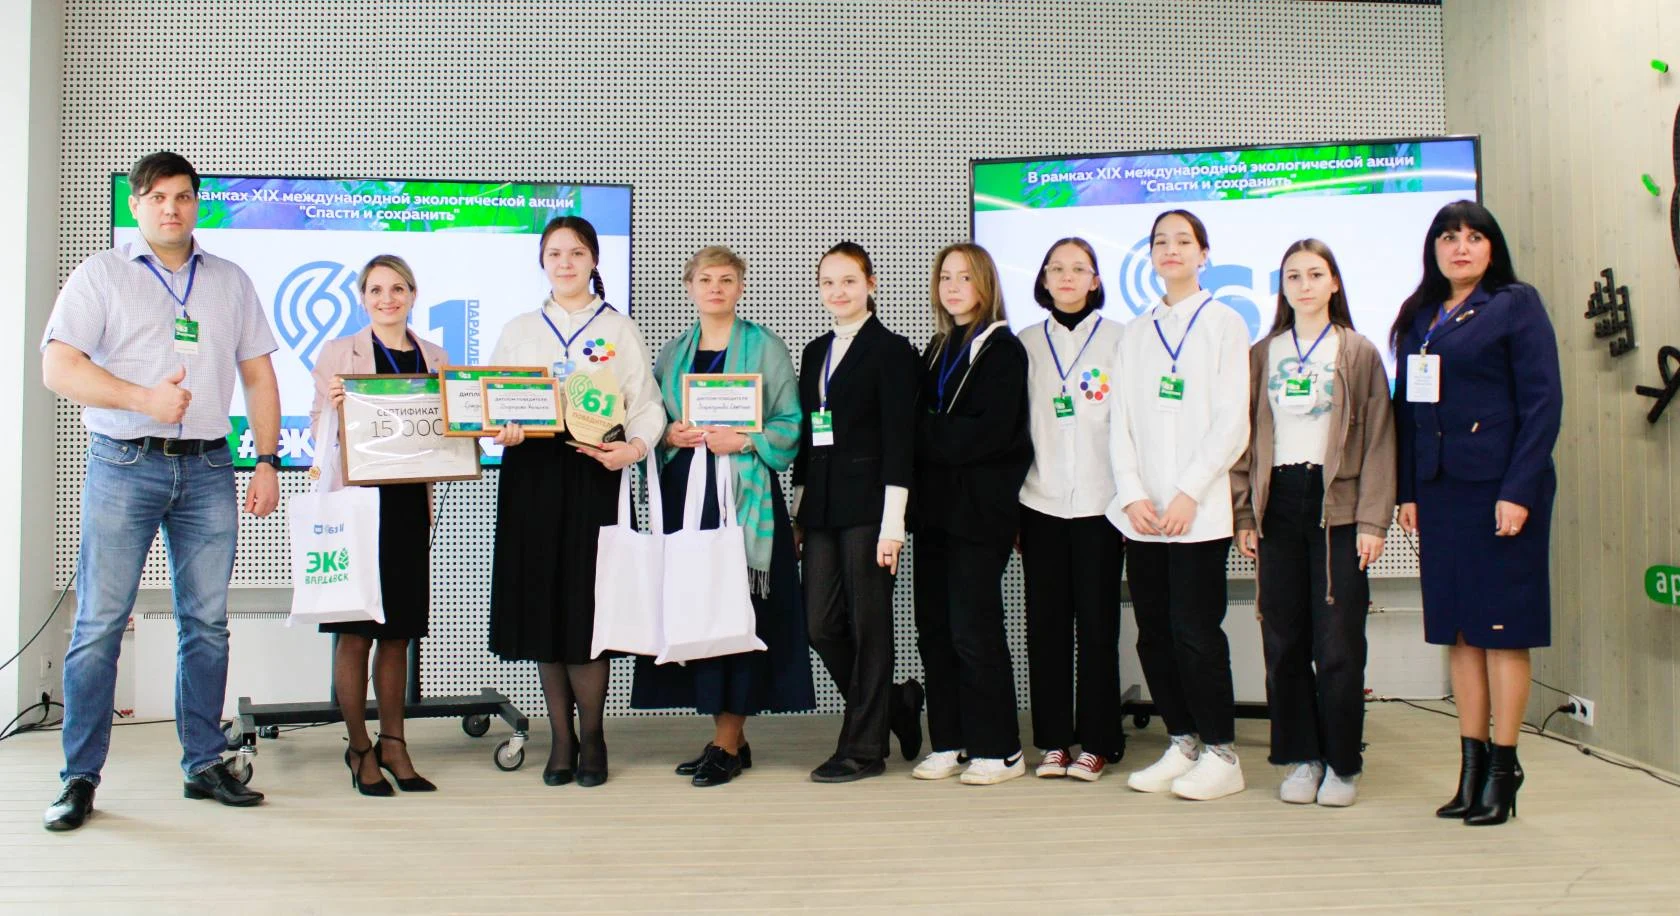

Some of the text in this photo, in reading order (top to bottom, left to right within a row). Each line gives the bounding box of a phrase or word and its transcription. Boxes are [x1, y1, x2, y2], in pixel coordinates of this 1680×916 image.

[1028, 171, 1038, 183] В
[1041, 171, 1093, 186] рамках
[1124, 162, 1247, 180] международной
[1250, 156, 1363, 172] экологической
[1366, 155, 1414, 169] акции
[1201, 180, 1210, 189] и
[198, 190, 248, 202] амках
[282, 192, 410, 206] международной
[413, 195, 525, 209] экологической
[529, 197, 574, 210] акции
[363, 208, 372, 218] и
[371, 420, 394, 438] 15
